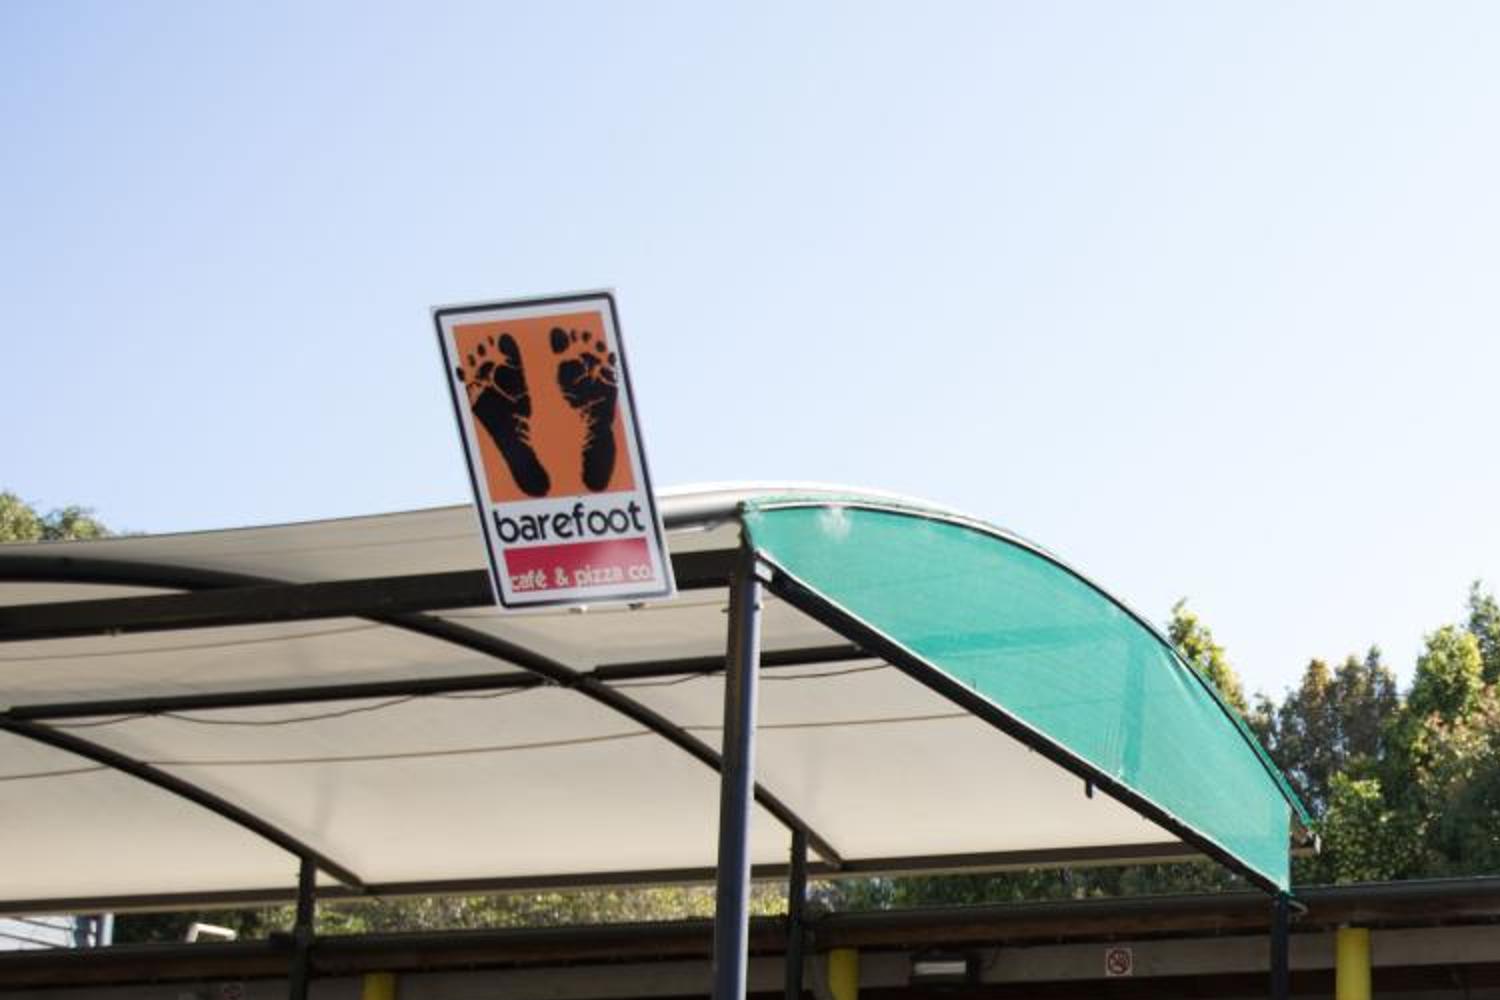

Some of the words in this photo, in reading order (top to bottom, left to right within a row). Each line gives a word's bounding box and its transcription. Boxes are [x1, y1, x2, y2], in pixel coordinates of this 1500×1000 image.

[492, 501, 646, 543] barefoot
[555, 566, 570, 587] &
[574, 564, 624, 587] pizza
